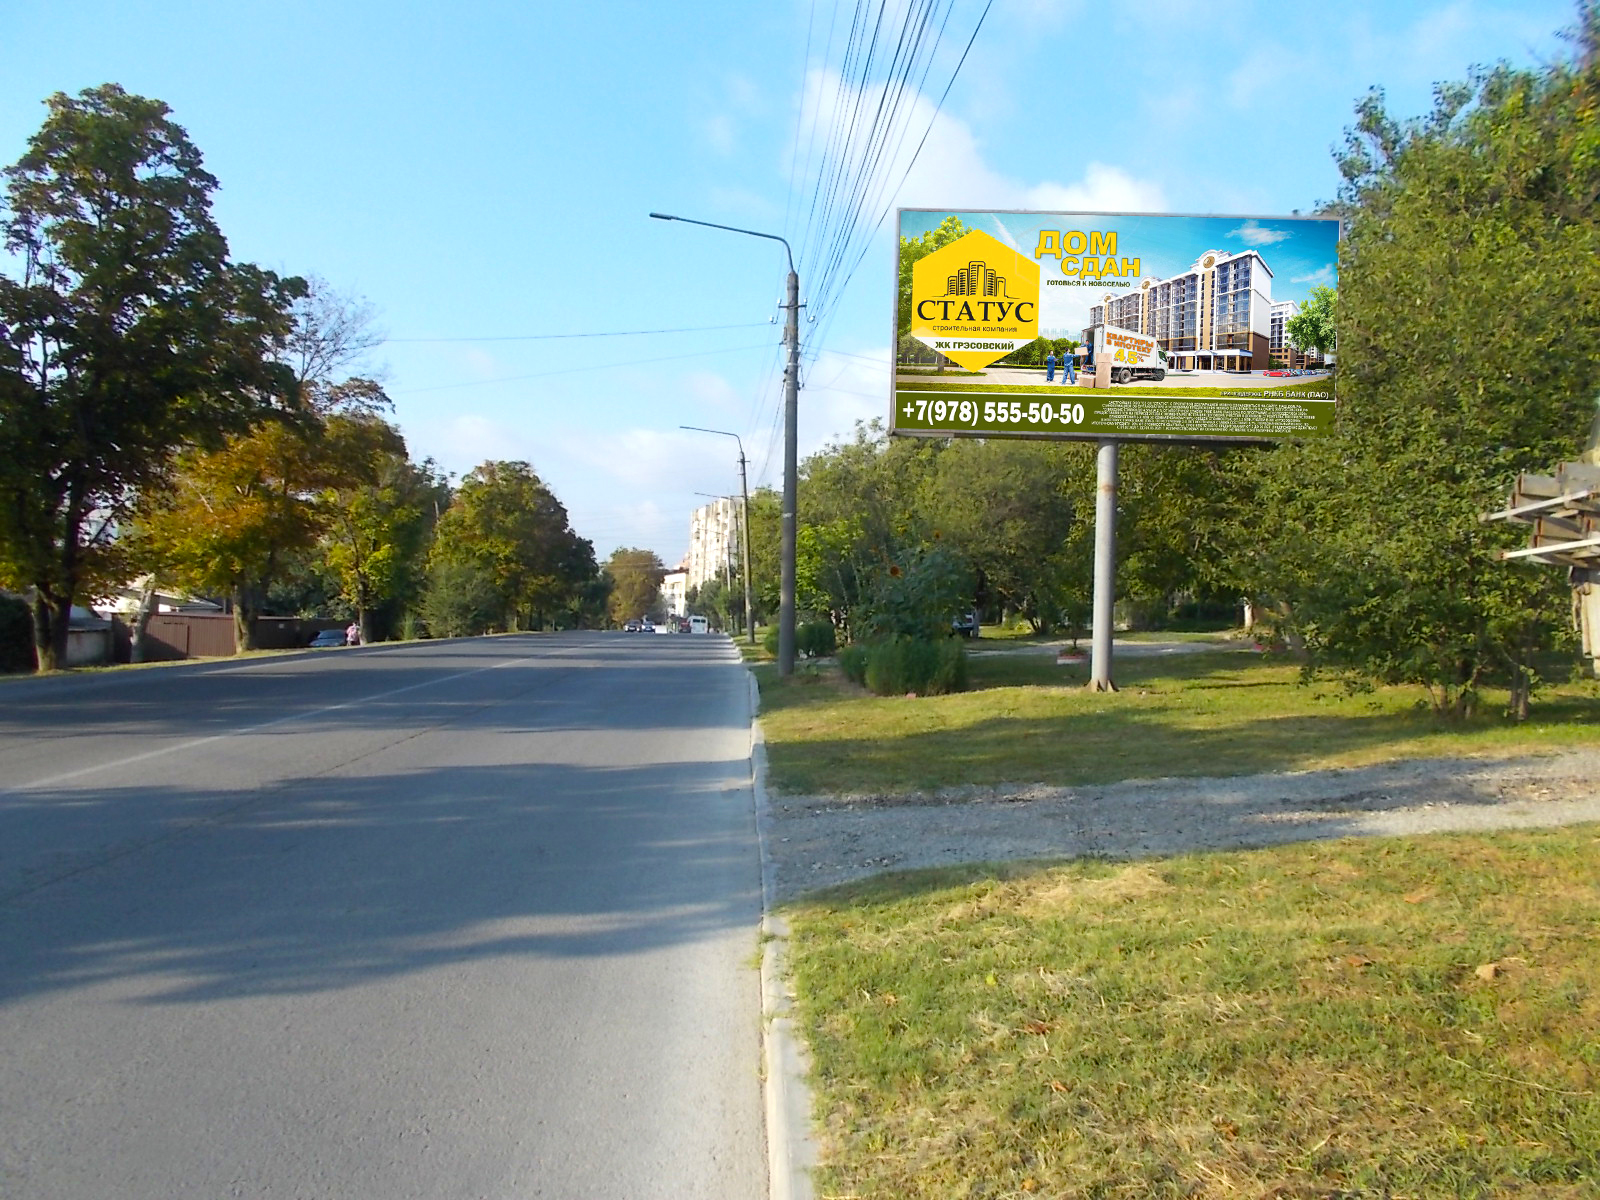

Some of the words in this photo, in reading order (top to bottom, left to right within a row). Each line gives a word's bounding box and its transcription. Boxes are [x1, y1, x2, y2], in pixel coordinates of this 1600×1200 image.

[1035, 230, 1118, 259] ДОМ
[1061, 256, 1141, 280] СДАН
[917, 300, 1034, 323] СТАТУС
[932, 325, 981, 333] строительная
[935, 341, 951, 349] ЖК
[953, 341, 1015, 350] ГРЭСОВСКИЙ
[1106, 332, 1154, 348] КВАРТИРЫ
[1114, 340, 1152, 353] ИПОТЕКУ
[1307, 391, 1329, 399] (ПАО)
[902, 400, 979, 426] +7(978)
[983, 401, 1085, 425] 555-50-50
